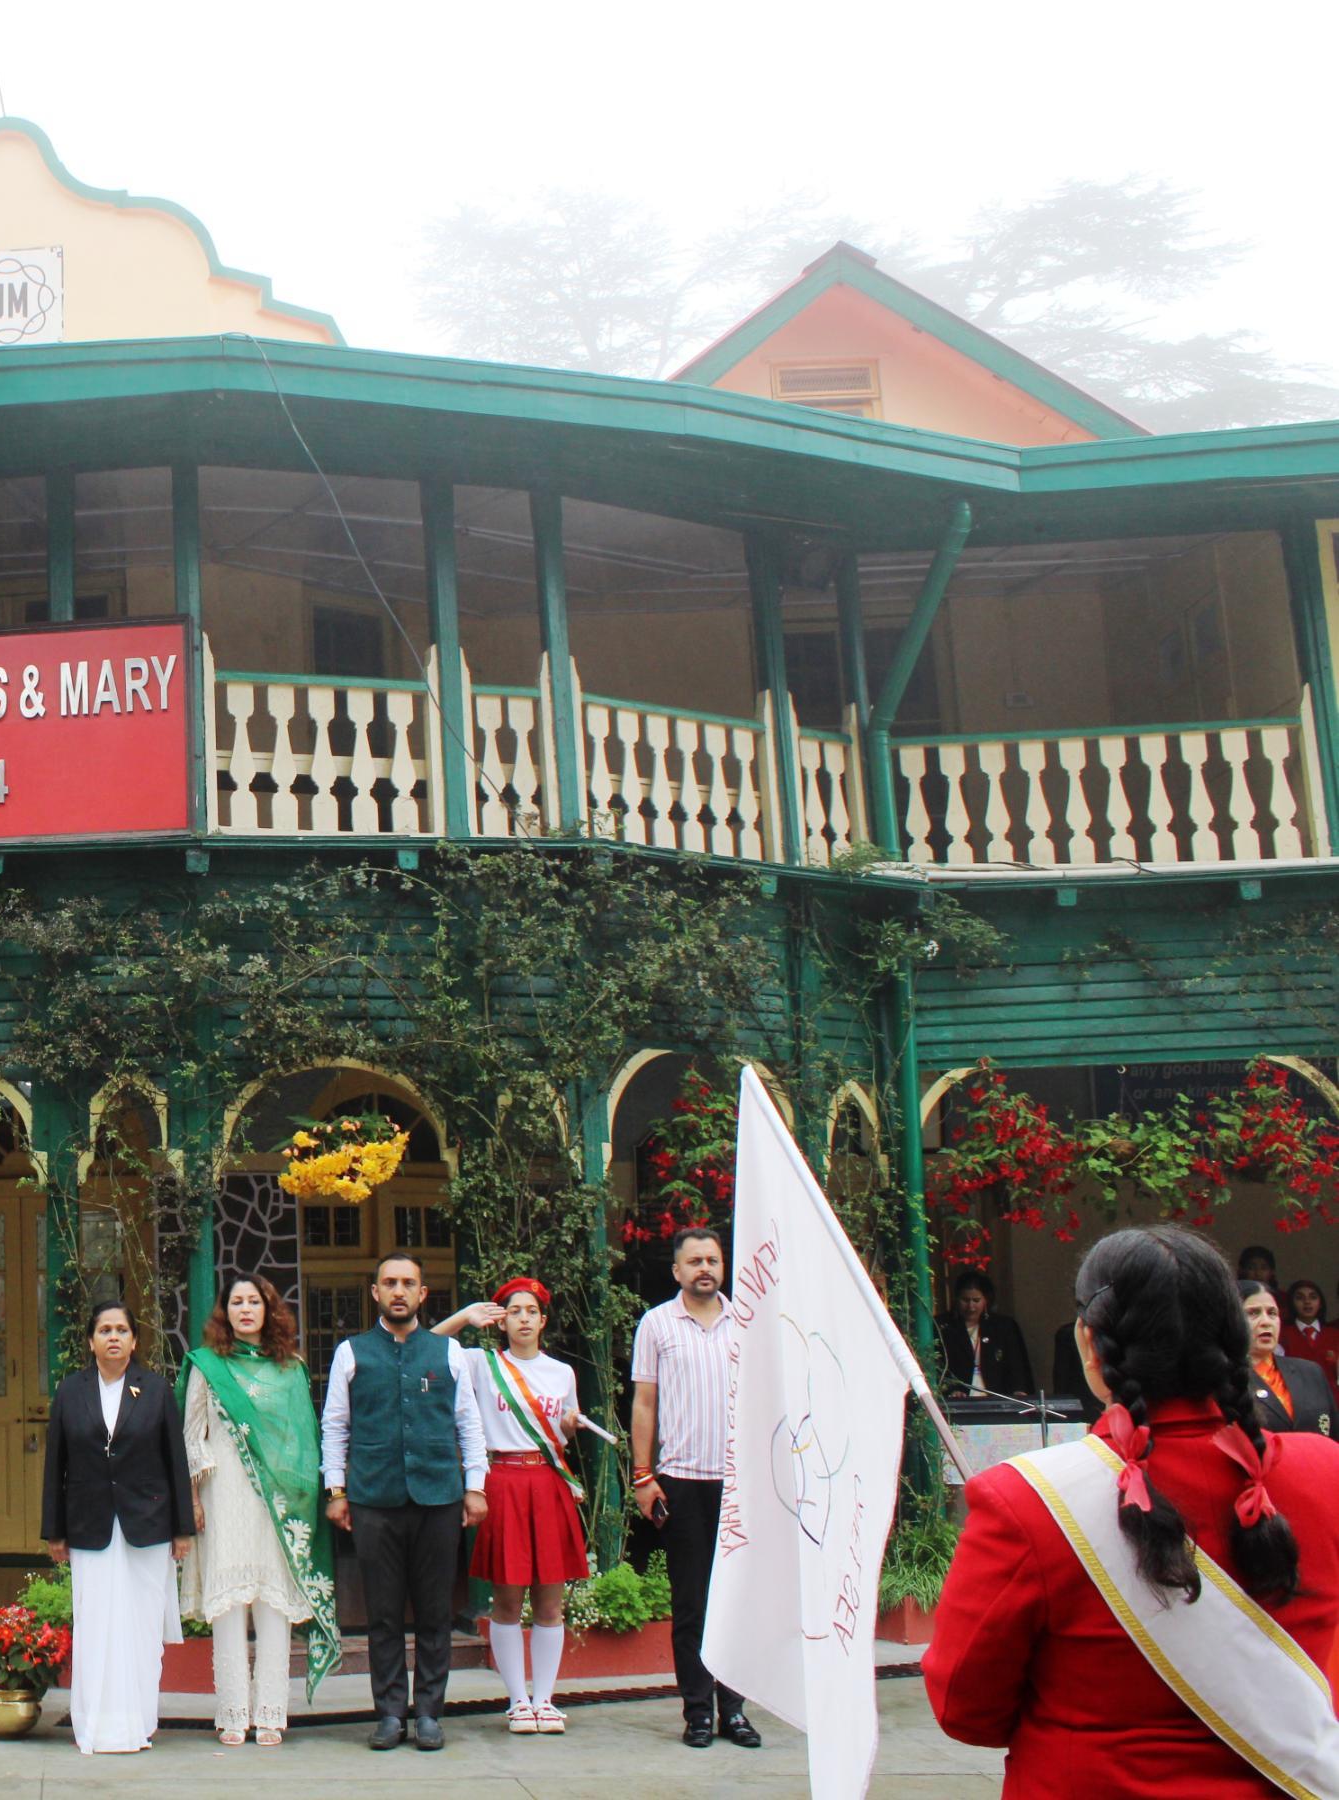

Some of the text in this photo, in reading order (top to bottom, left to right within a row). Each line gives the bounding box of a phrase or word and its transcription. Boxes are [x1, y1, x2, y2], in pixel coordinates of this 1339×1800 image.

[18, 664, 47, 719] &
[60, 653, 178, 717] MARY
[1162, 1062, 1206, 1079] good
